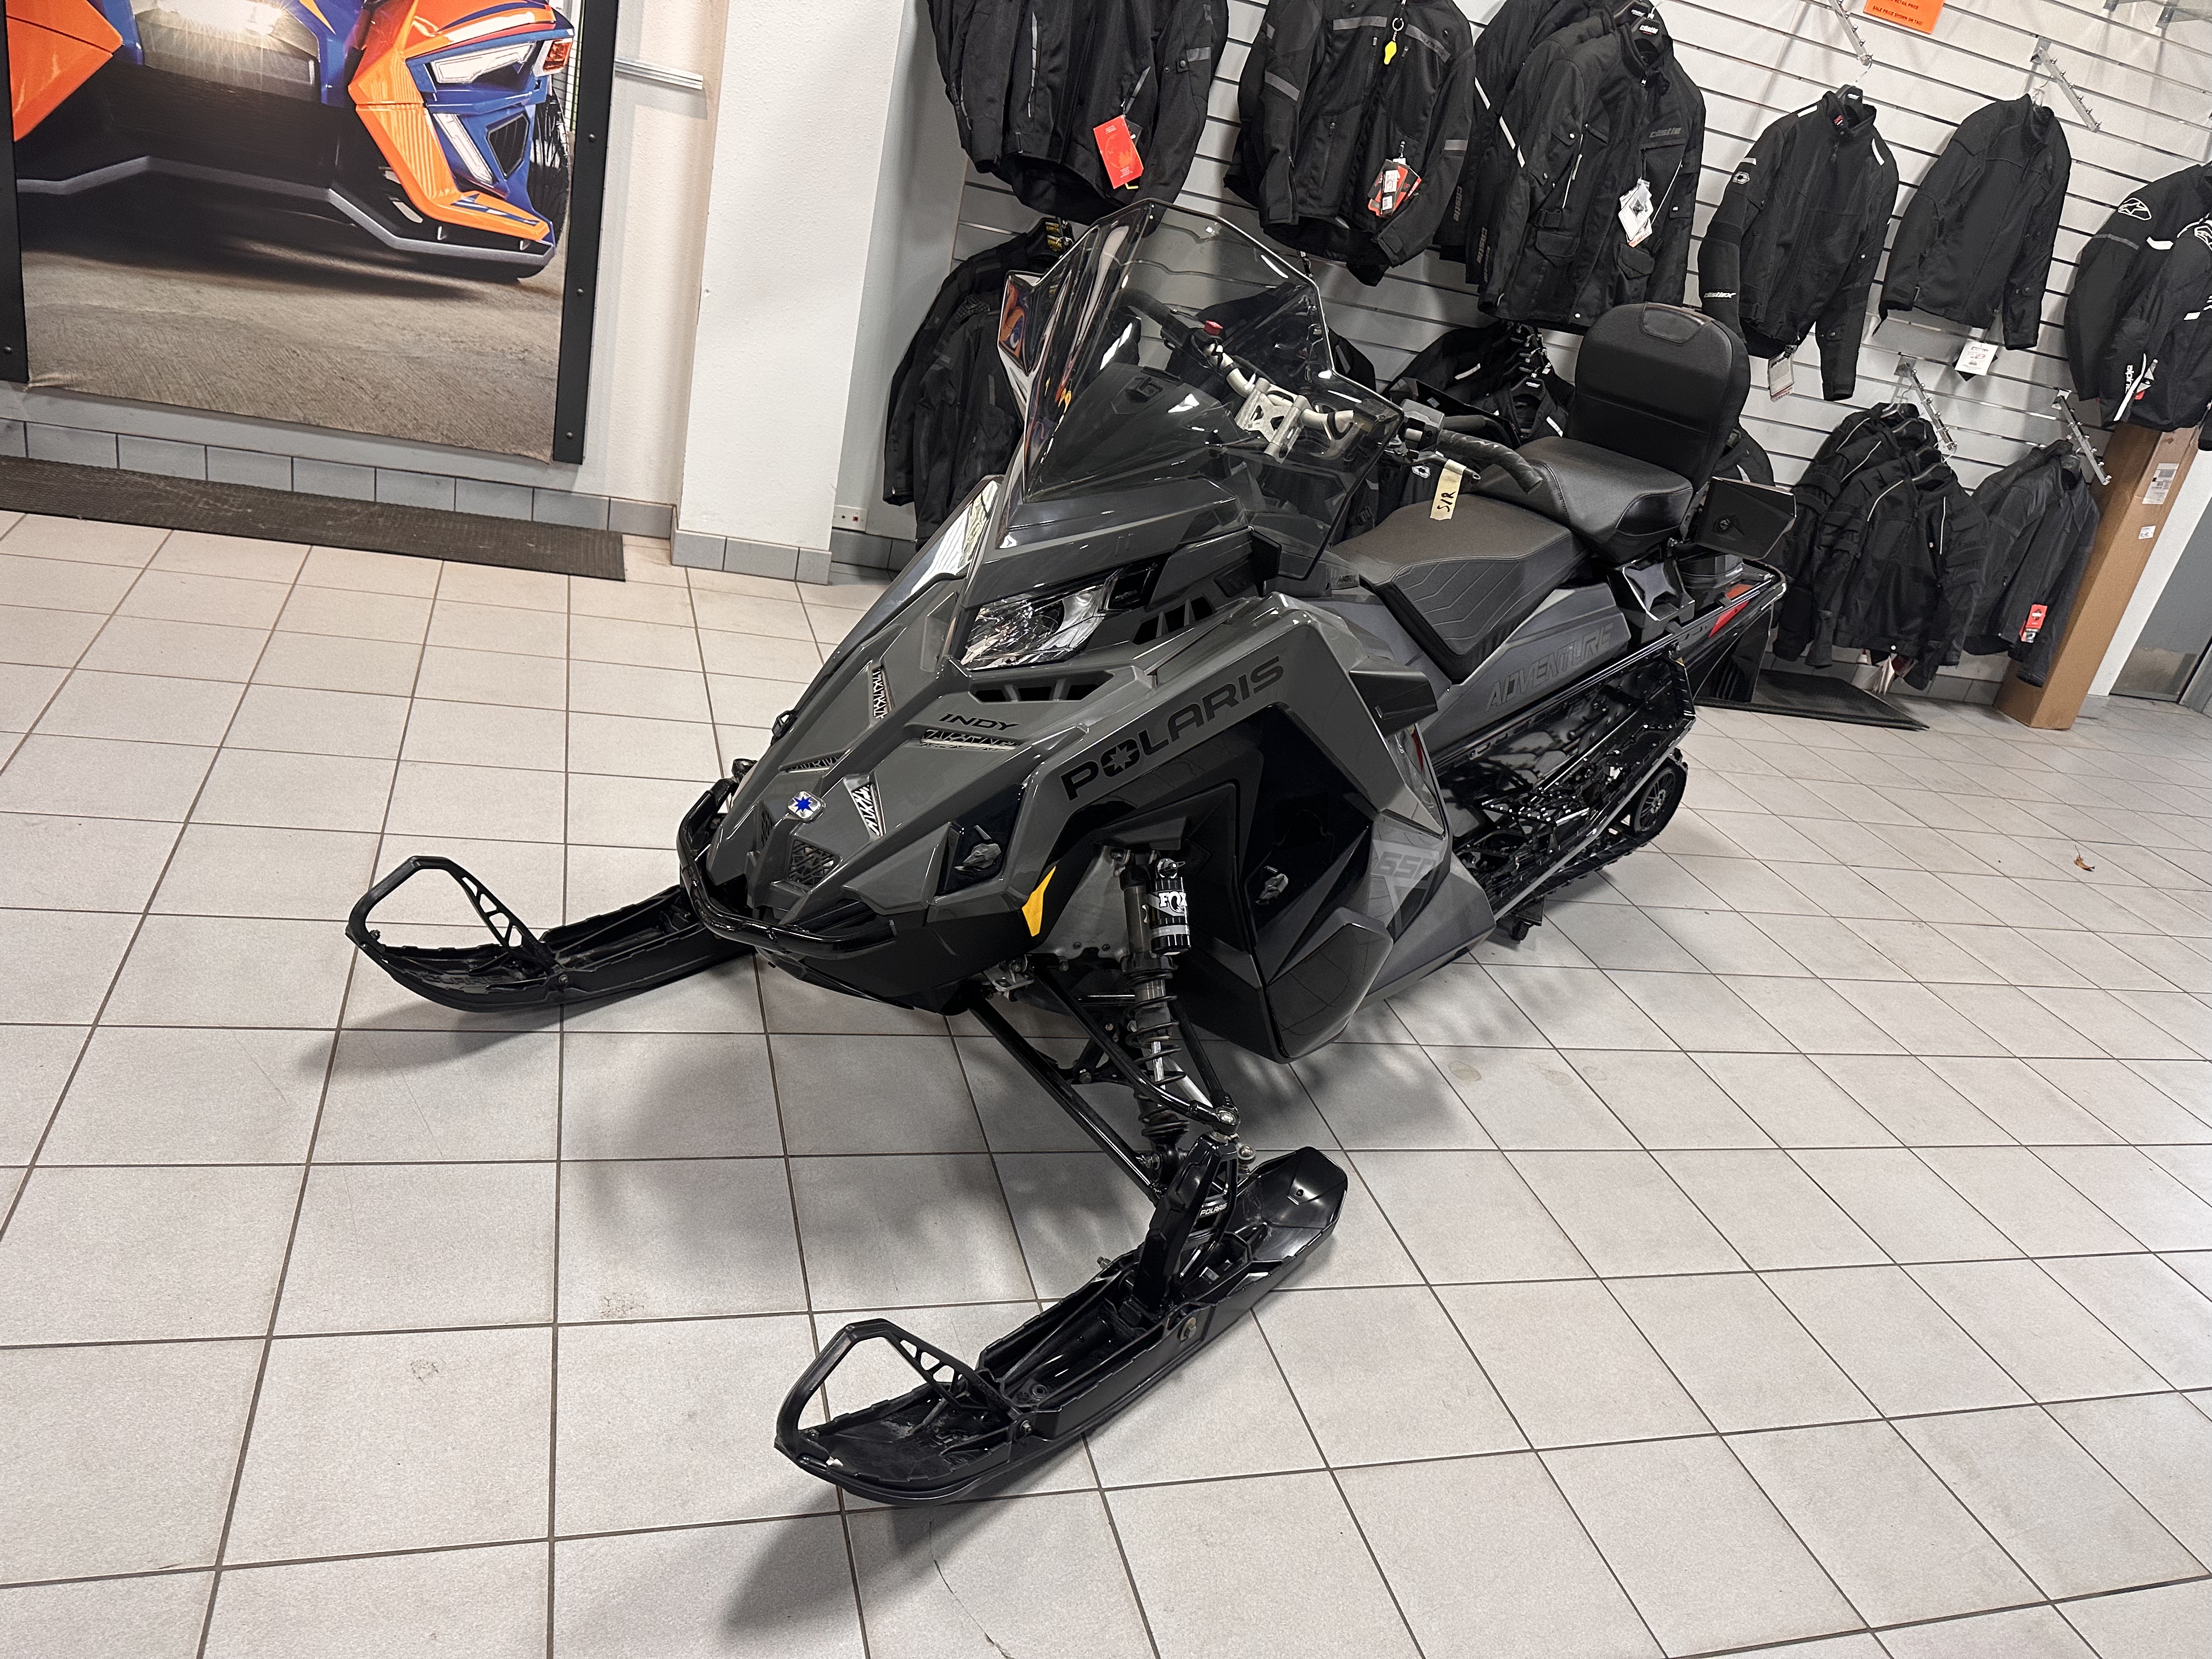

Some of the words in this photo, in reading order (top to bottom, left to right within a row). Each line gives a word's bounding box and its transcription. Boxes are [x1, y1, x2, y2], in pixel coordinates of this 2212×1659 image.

[1483, 622, 1614, 712] ADVENTURE
[939, 713, 1019, 731] INDY
[1060, 656, 1284, 802] POLARIS
[1159, 891, 1187, 913] FOX
[1199, 1202, 1228, 1216] POLARIS
